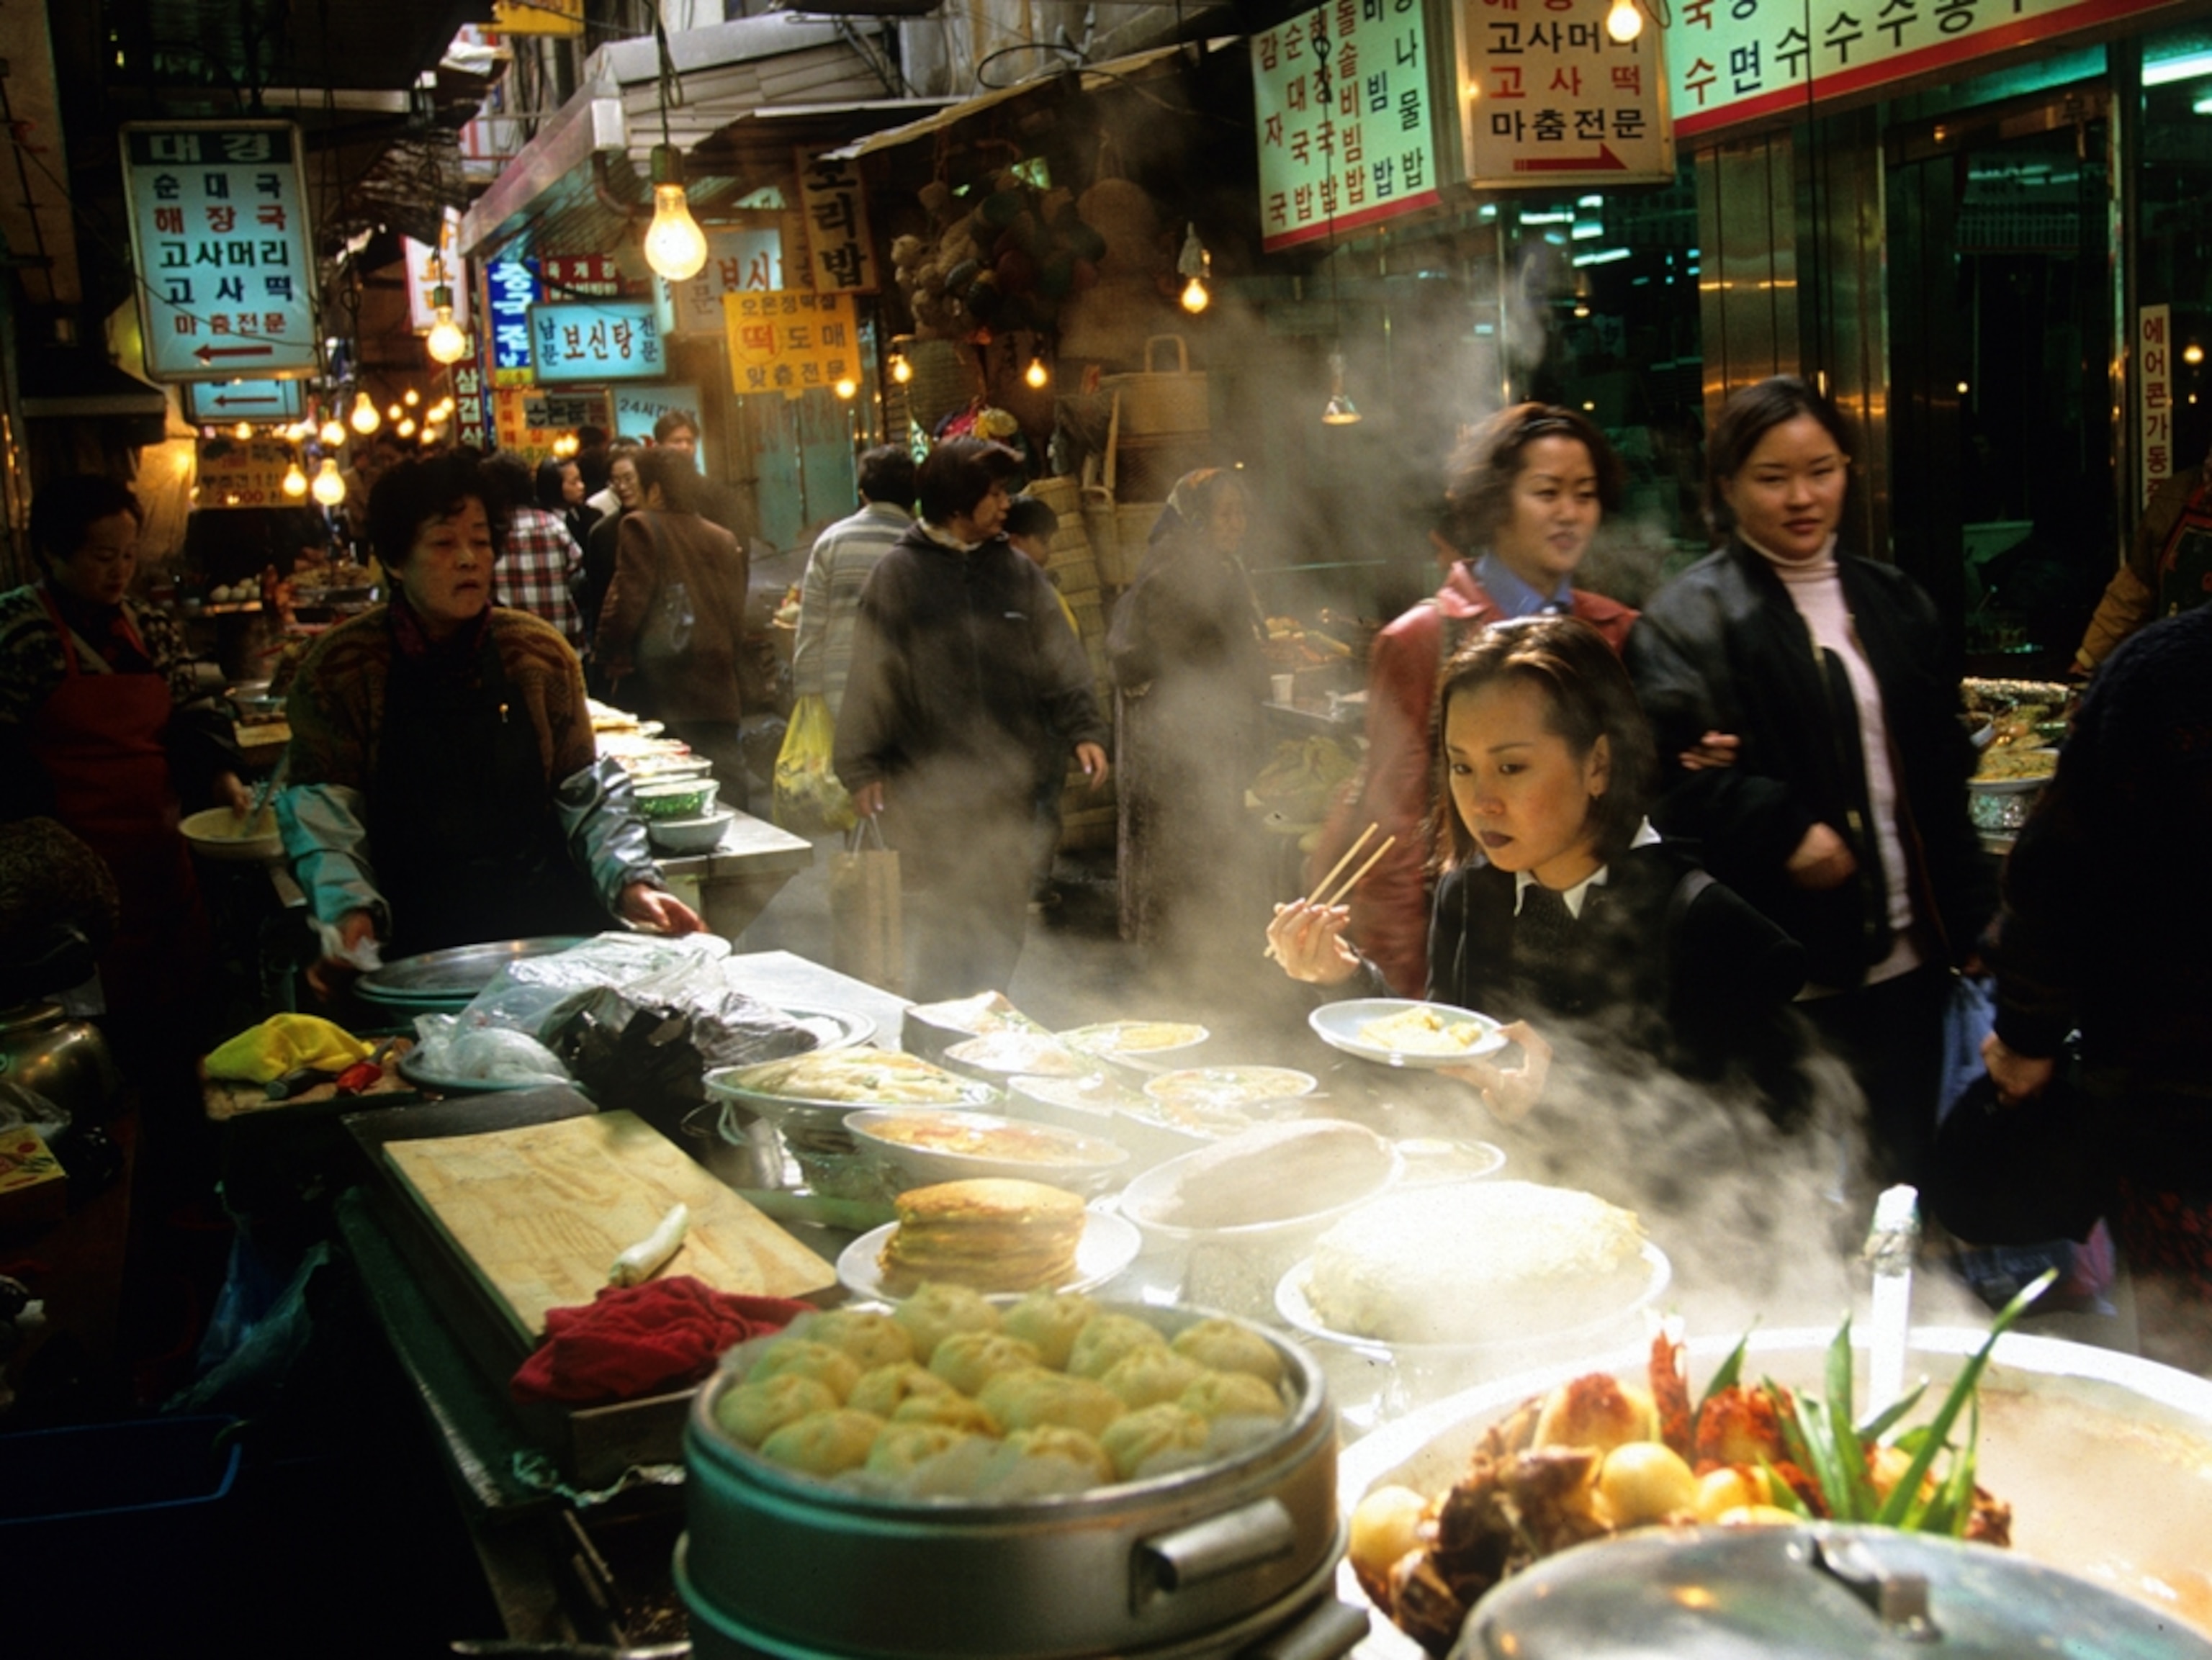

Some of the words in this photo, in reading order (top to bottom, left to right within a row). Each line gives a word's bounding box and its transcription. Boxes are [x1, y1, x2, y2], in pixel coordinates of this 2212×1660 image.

[1259, 32, 1287, 226] 감자국
[1284, 23, 1313, 222] 순대국밥
[1492, 108, 1646, 143] 마춤전문
[150, 134, 271, 162] 대경
[154, 173, 282, 199] 순대국
[154, 206, 287, 234] 해장국
[160, 241, 289, 268] 고사머리
[164, 276, 293, 305] 고사떡
[563, 319, 633, 360] 보신탕
[742, 324, 775, 355] 떡
